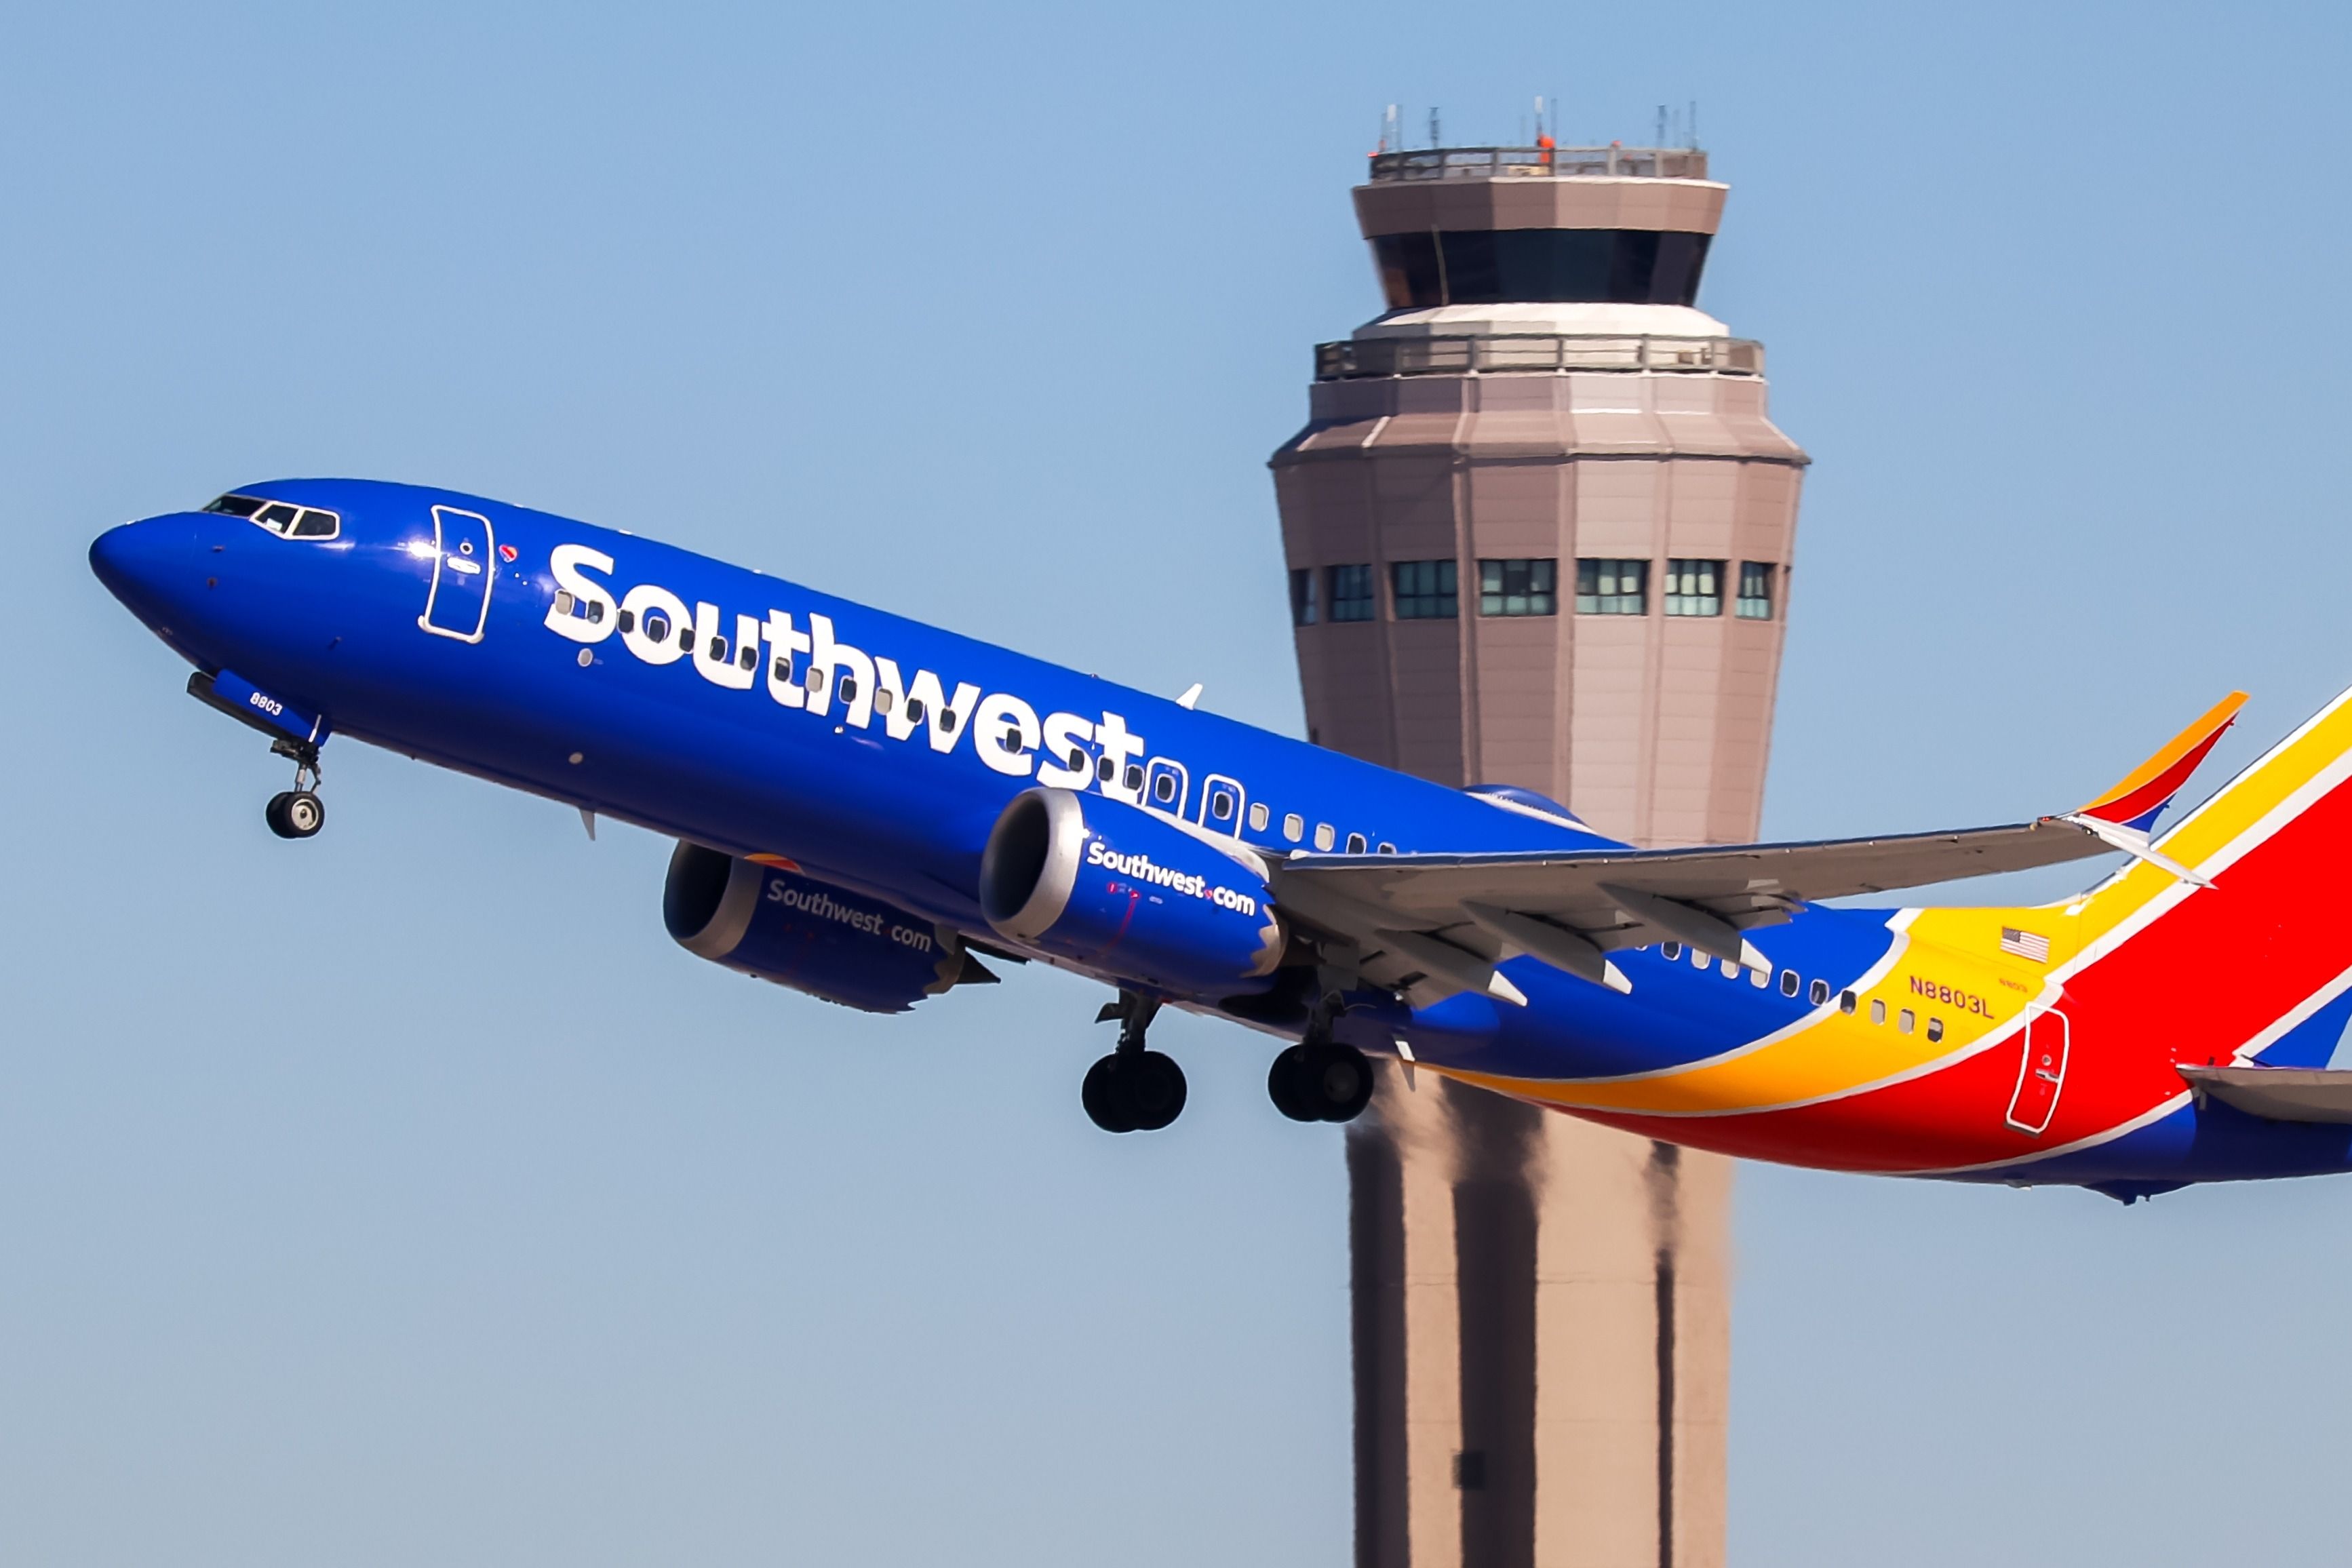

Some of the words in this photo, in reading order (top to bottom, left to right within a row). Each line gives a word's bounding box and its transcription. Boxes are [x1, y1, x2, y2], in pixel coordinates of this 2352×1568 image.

[544, 543, 1144, 805] Southwest
[250, 692, 283, 716] 8803
[1910, 975, 1995, 1019] N8803L
